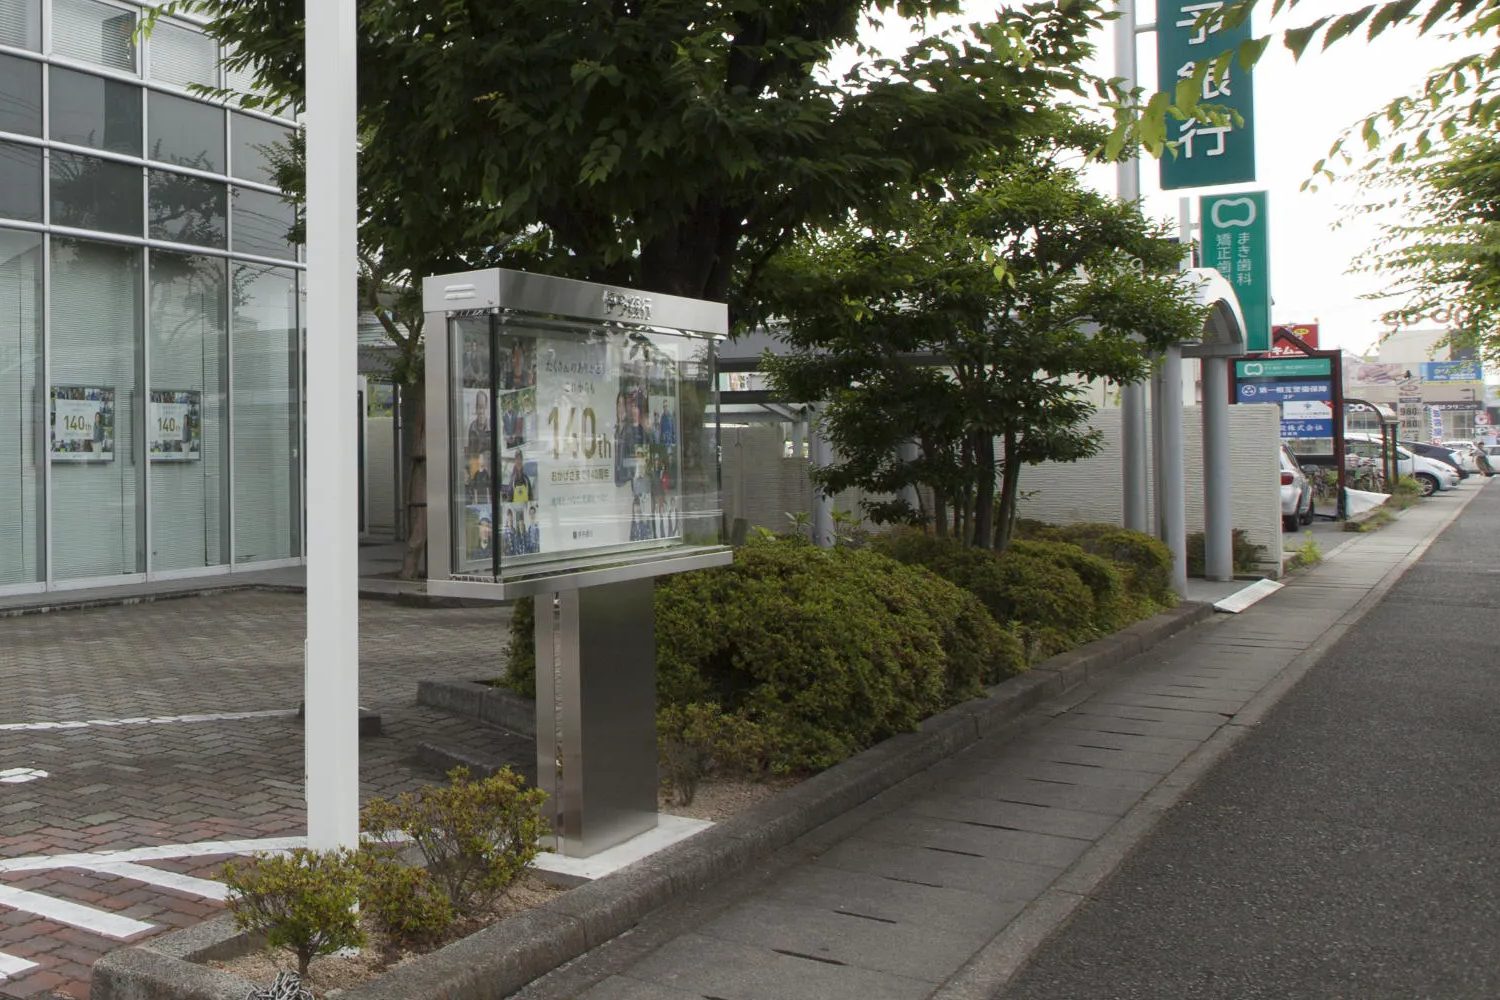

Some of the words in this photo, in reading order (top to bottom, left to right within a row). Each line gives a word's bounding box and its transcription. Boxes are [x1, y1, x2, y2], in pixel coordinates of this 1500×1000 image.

[1236, 232, 1253, 286] まき歯科
[63, 415, 92, 431] 140th
[157, 417, 181, 432] 140th
